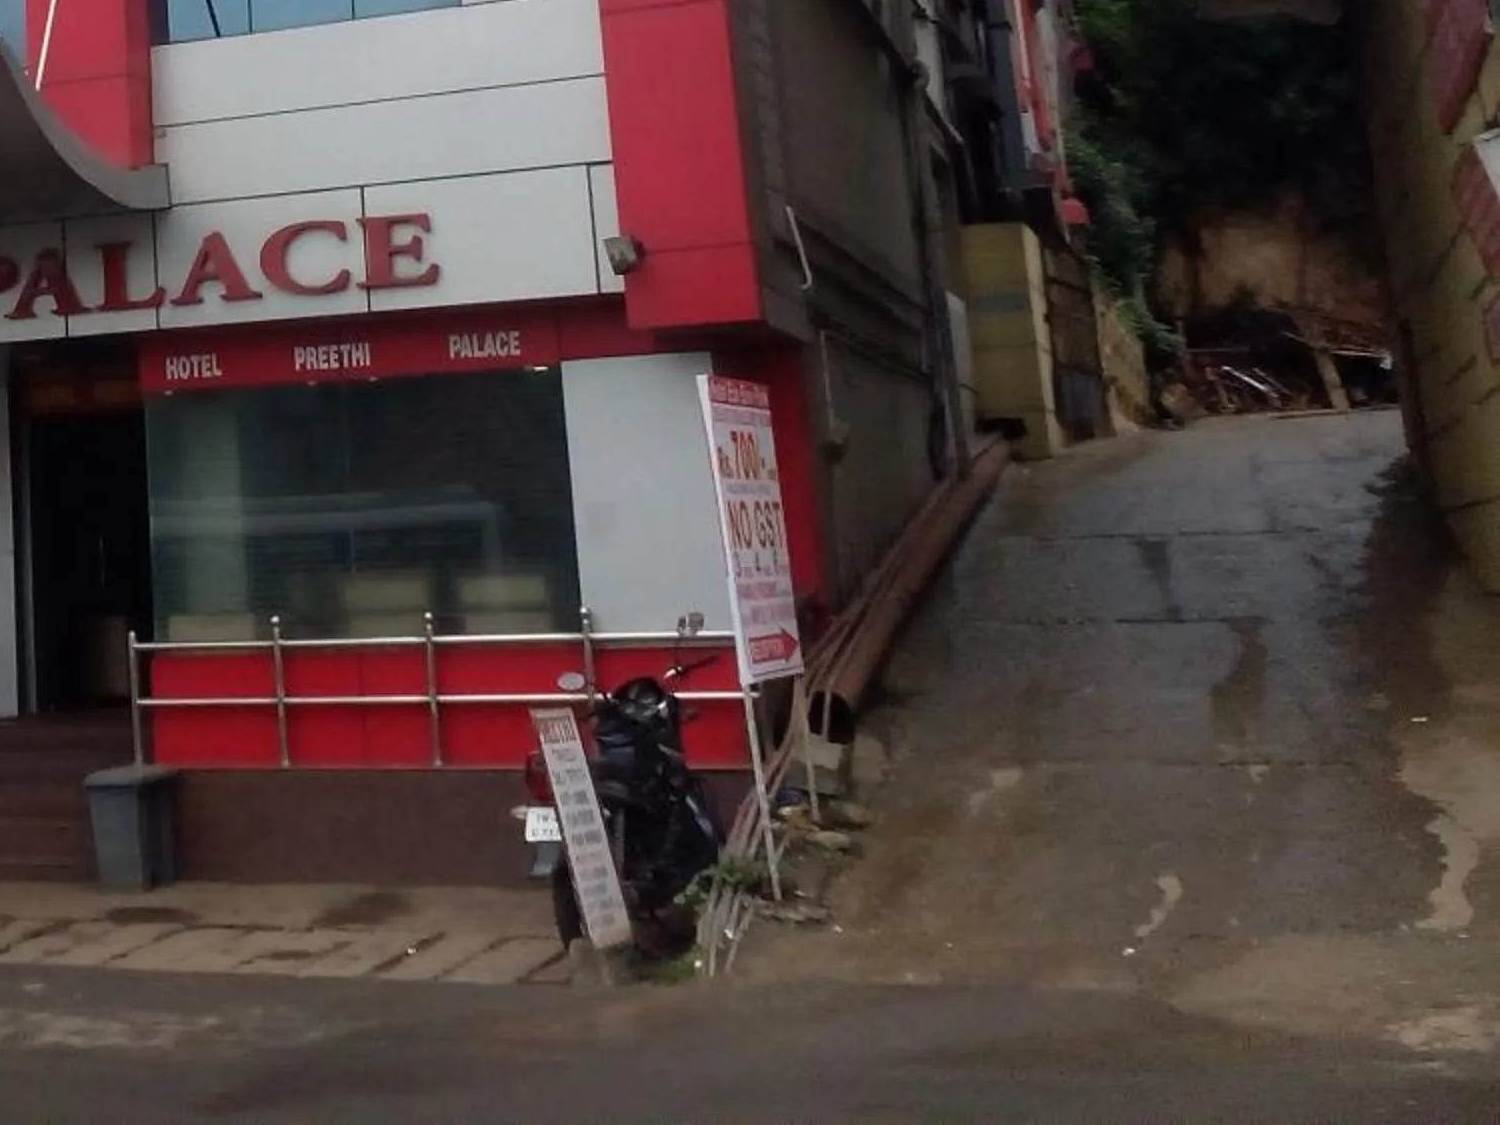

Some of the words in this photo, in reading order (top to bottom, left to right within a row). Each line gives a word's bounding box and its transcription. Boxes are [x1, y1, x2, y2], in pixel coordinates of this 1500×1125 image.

[165, 353, 223, 380] HOTEL
[294, 342, 371, 371] PREETHI
[449, 331, 521, 359] PALACE
[727, 499, 752, 550] NO
[753, 499, 783, 550] GST
